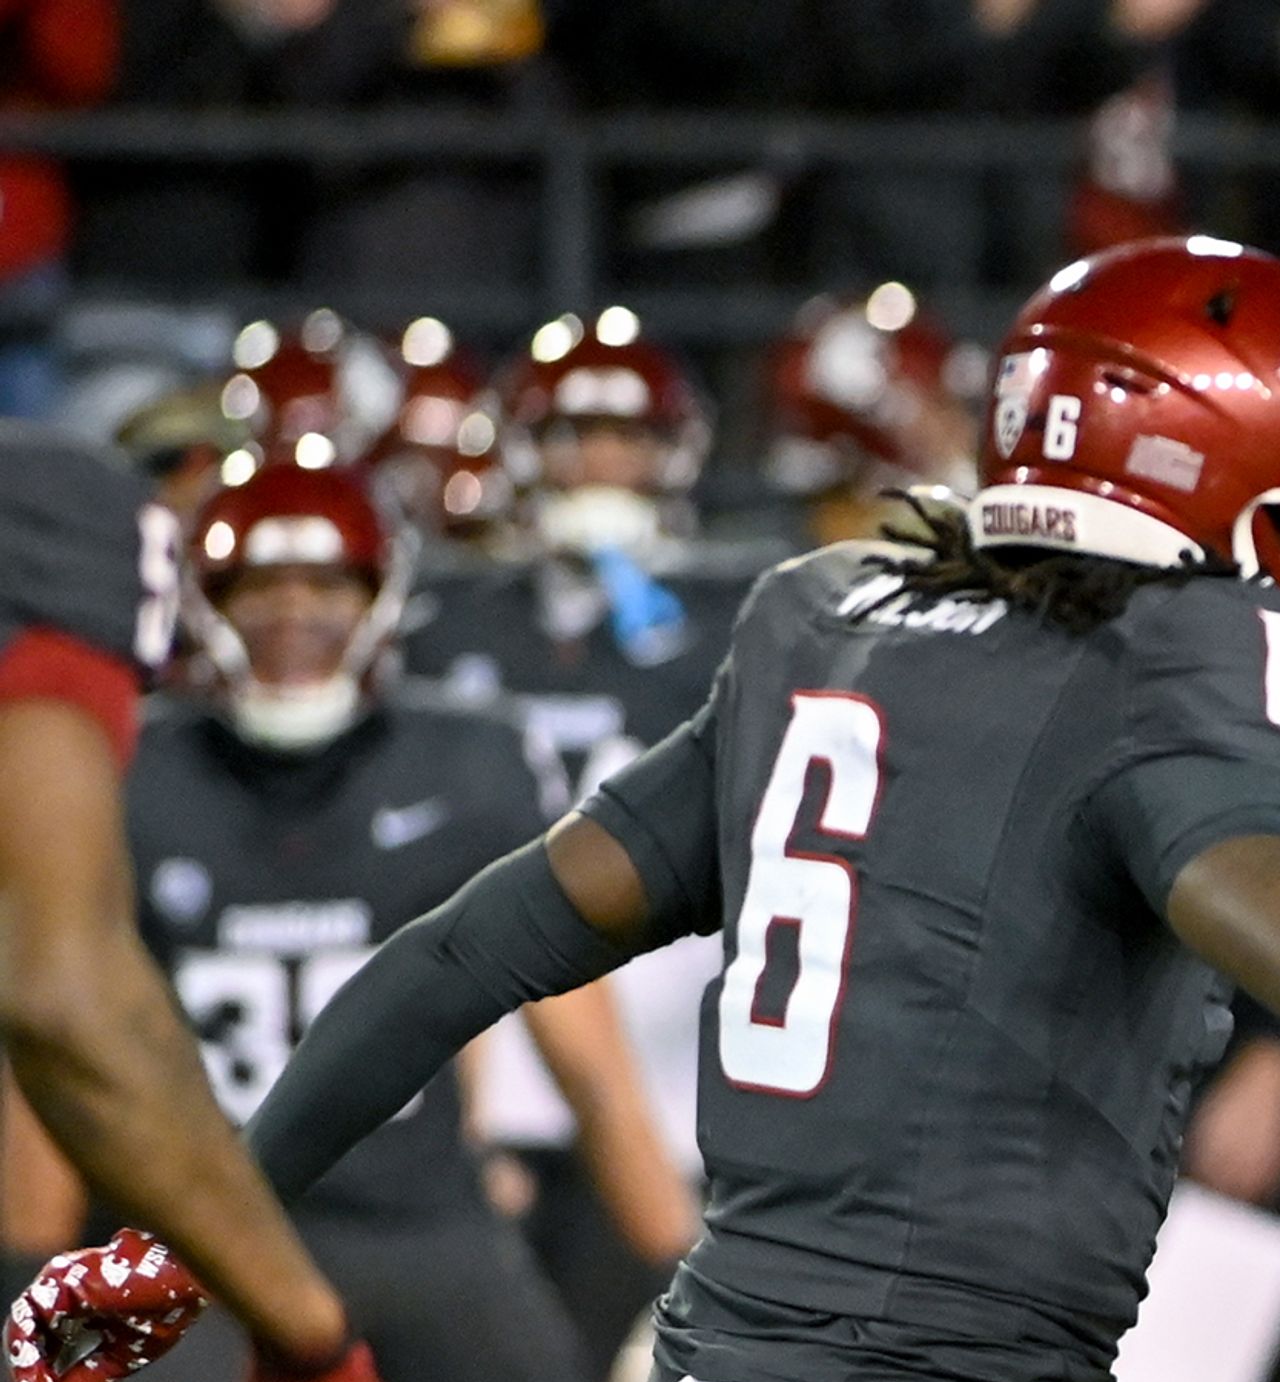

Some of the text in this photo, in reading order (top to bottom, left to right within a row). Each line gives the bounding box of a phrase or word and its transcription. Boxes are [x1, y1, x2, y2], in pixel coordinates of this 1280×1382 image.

[1043, 394, 1081, 461] 6
[982, 502, 1077, 542] COUGARS
[718, 689, 888, 1099] 6
[135, 1243, 169, 1279] WSU
